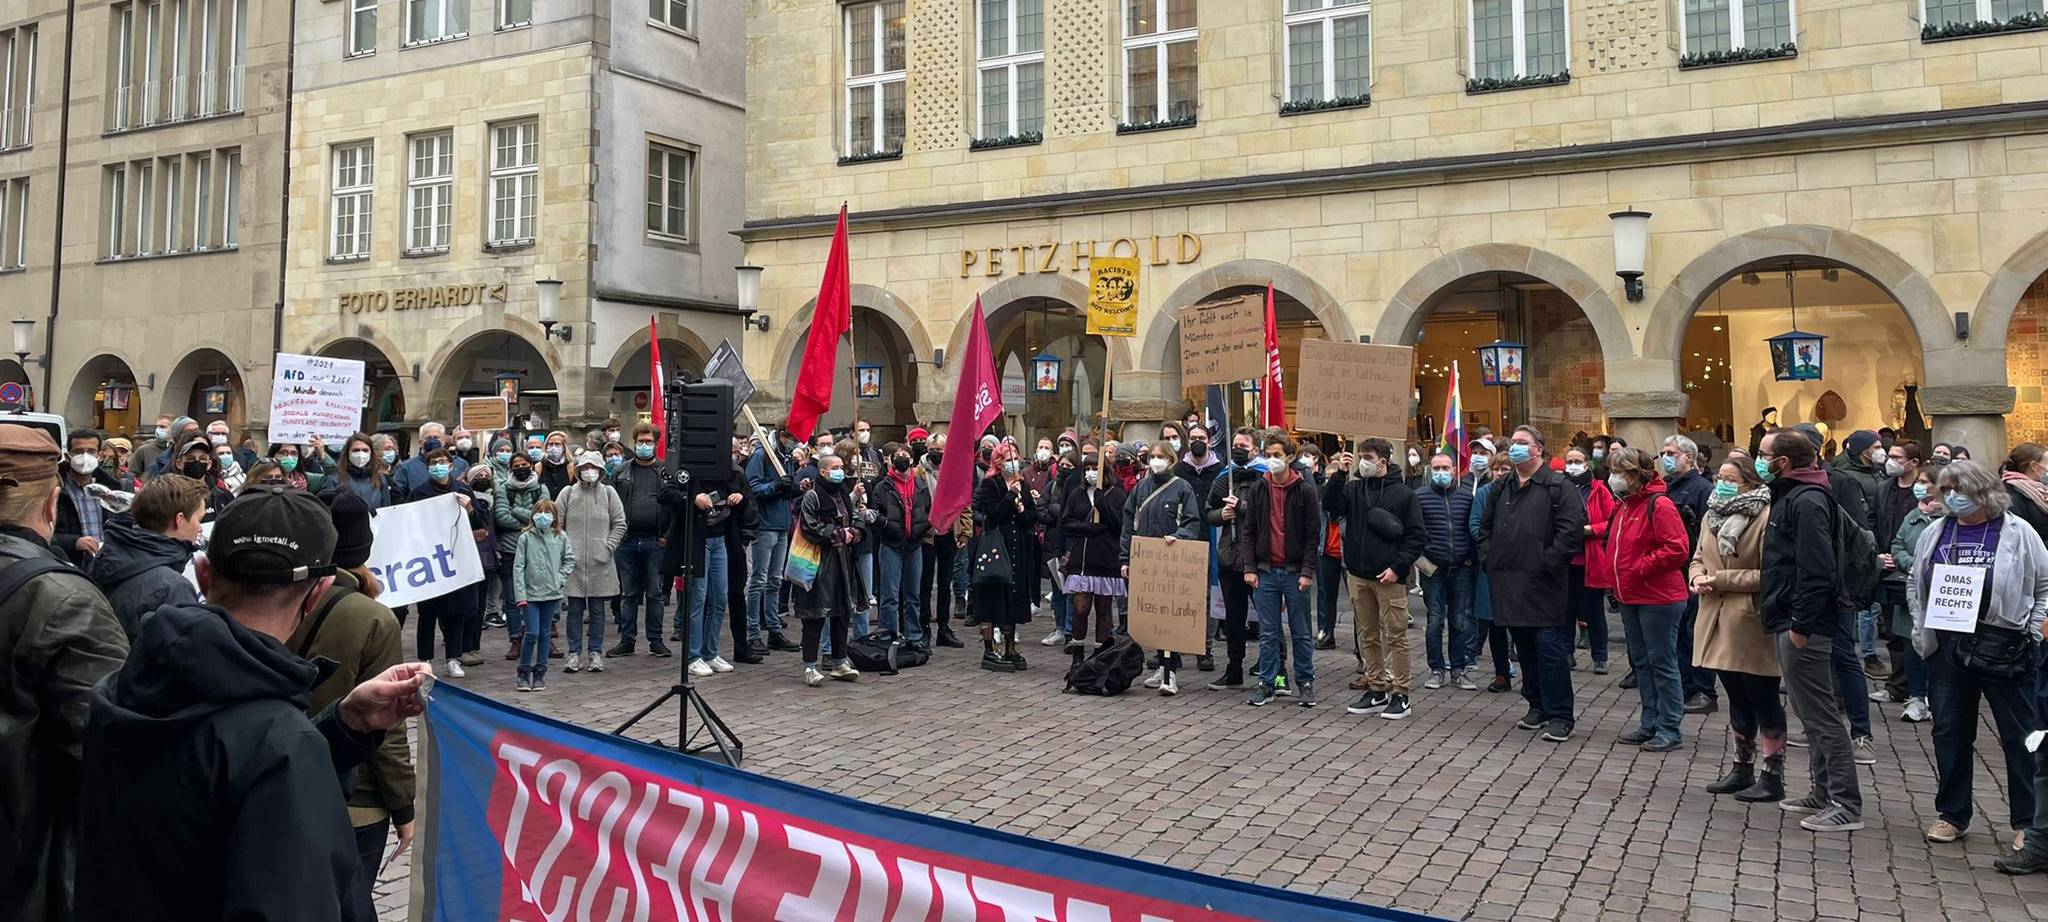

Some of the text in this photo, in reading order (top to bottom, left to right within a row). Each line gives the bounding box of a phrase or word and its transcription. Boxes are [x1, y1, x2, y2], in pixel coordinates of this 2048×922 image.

[960, 232, 1202, 278] PETZHOLD
[1097, 266, 1132, 277] RACISTS
[338, 283, 487, 315] FOTO ERHARDT
[1091, 301, 1134, 315] NOT WELCOME
[1183, 315, 1196, 328] Ihr
[1221, 308, 1238, 321] euch
[1184, 329, 1214, 344] Münster
[283, 369, 305, 380] AfD
[1185, 364, 1199, 375] das
[293, 430, 306, 439] der
[233, 534, 299, 551] www.igmetall.de
[1958, 556, 1974, 564] DASS
[1944, 574, 1972, 585] OMAS
[1939, 585, 1973, 597] GEGEN
[1136, 596, 1159, 615] Nazis
[1935, 597, 1973, 610] RECHTS
